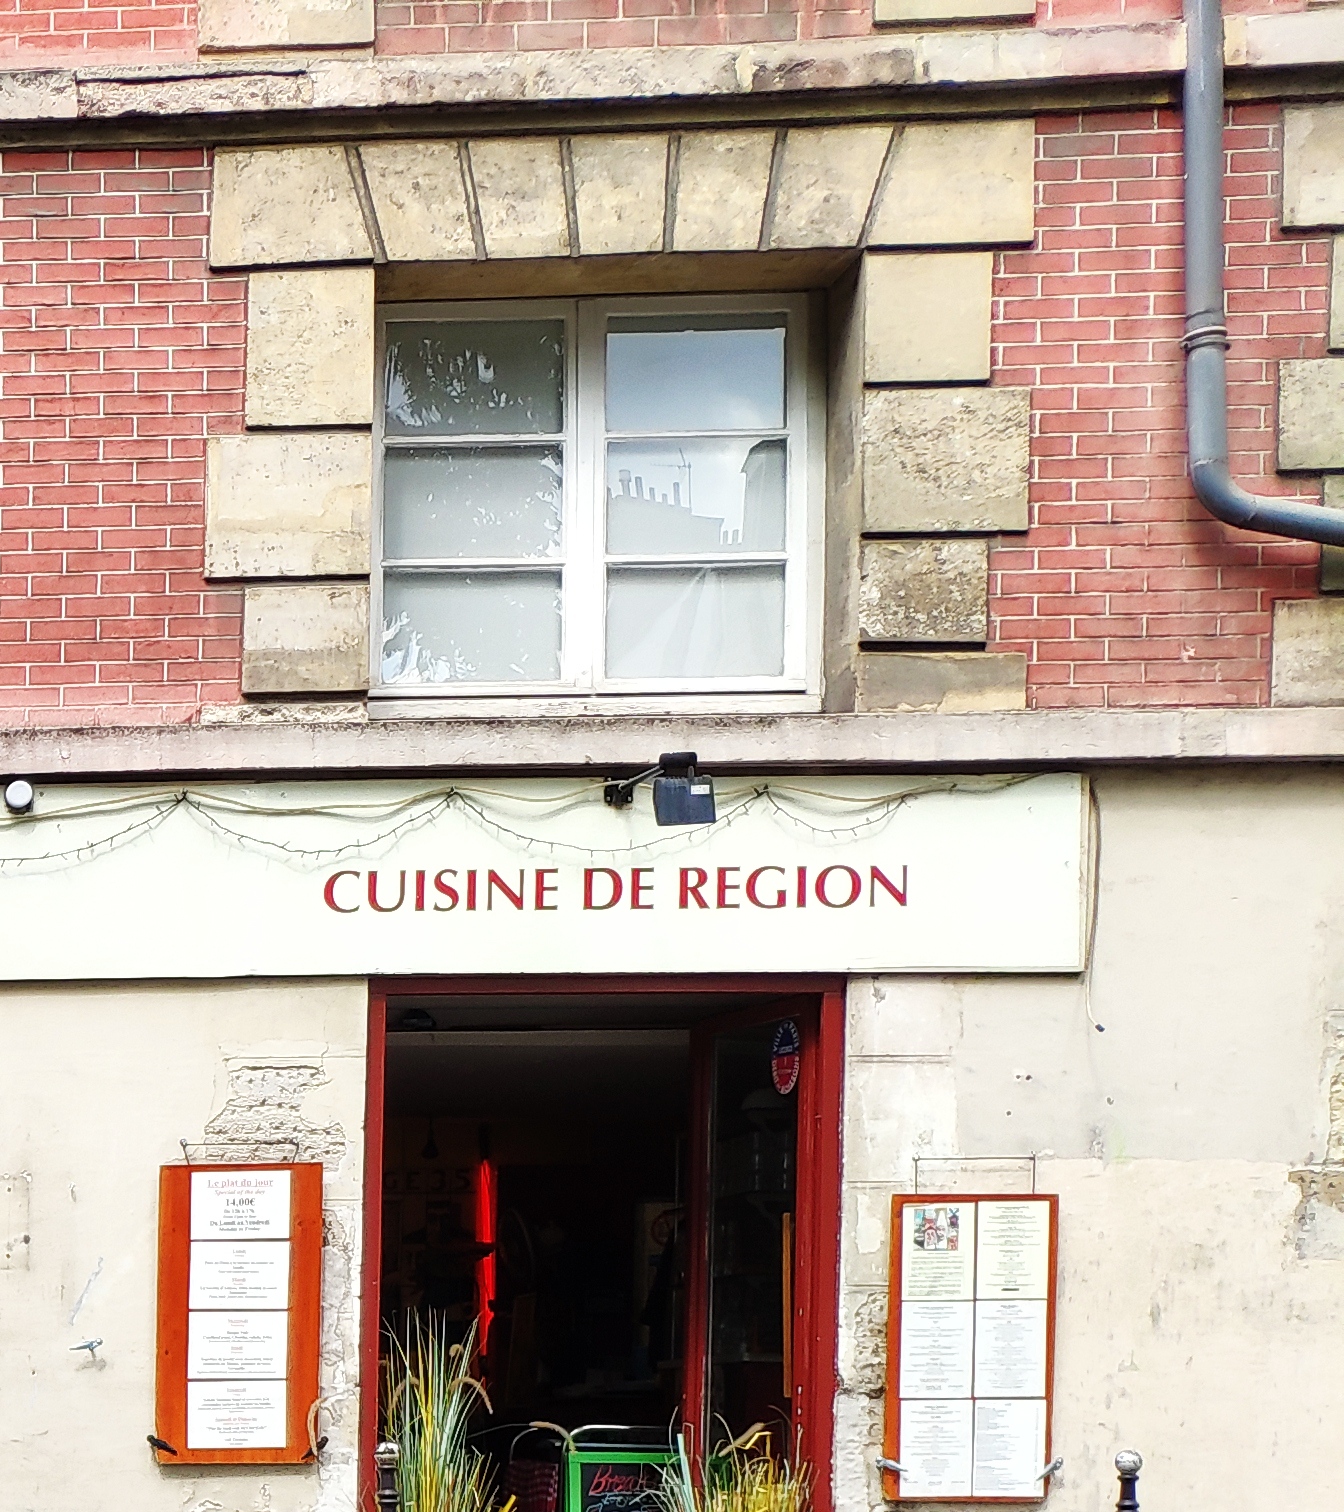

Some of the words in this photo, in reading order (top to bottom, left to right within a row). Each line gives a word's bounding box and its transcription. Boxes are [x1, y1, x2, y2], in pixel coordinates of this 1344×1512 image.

[323, 868, 559, 914] CUISINE
[582, 867, 656, 911] DE
[678, 864, 909, 910] REGION
[225, 1197, 256, 1208] 14,00€
